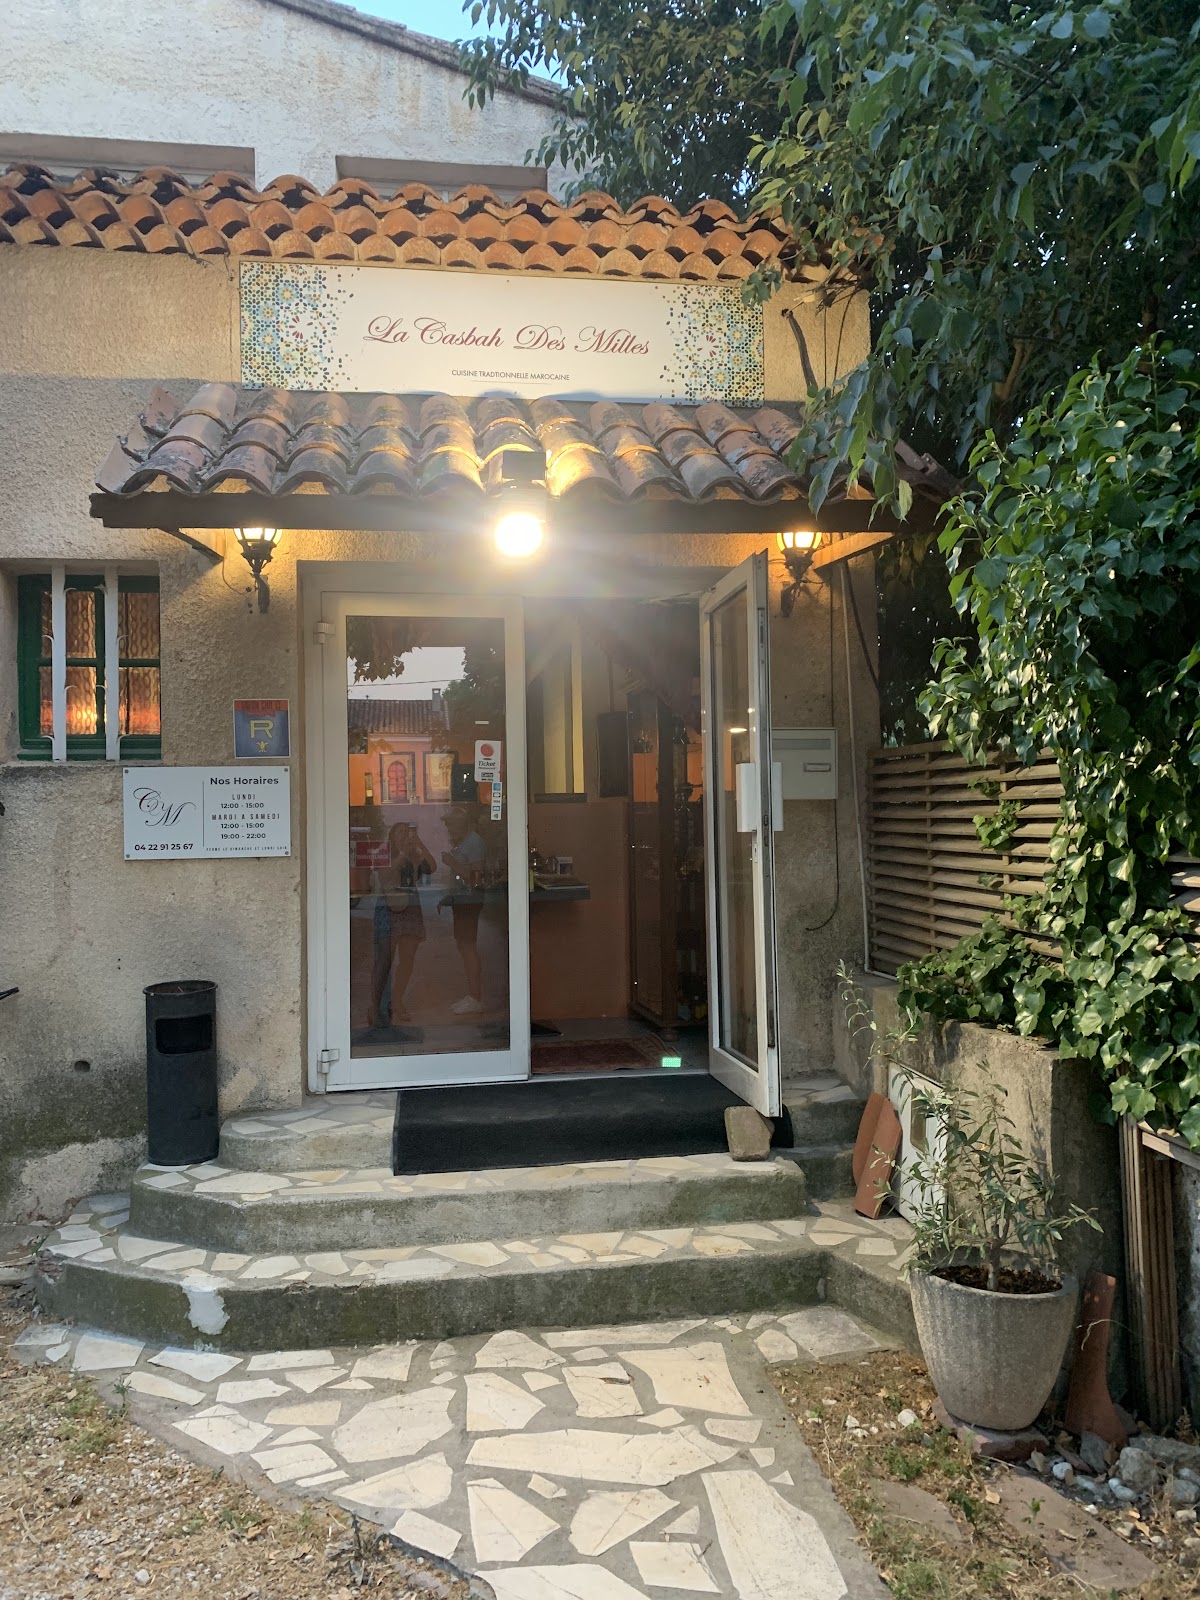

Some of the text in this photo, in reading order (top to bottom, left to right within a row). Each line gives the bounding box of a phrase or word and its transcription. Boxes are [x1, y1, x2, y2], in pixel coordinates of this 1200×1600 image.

[363, 316, 650, 355] La Casbah Des Milles
[451, 369, 478, 377] CUISINE
[530, 373, 570, 381] MAROCAINE
[250, 719, 273, 739] R
[210, 776, 279, 785] Nos Horaires
